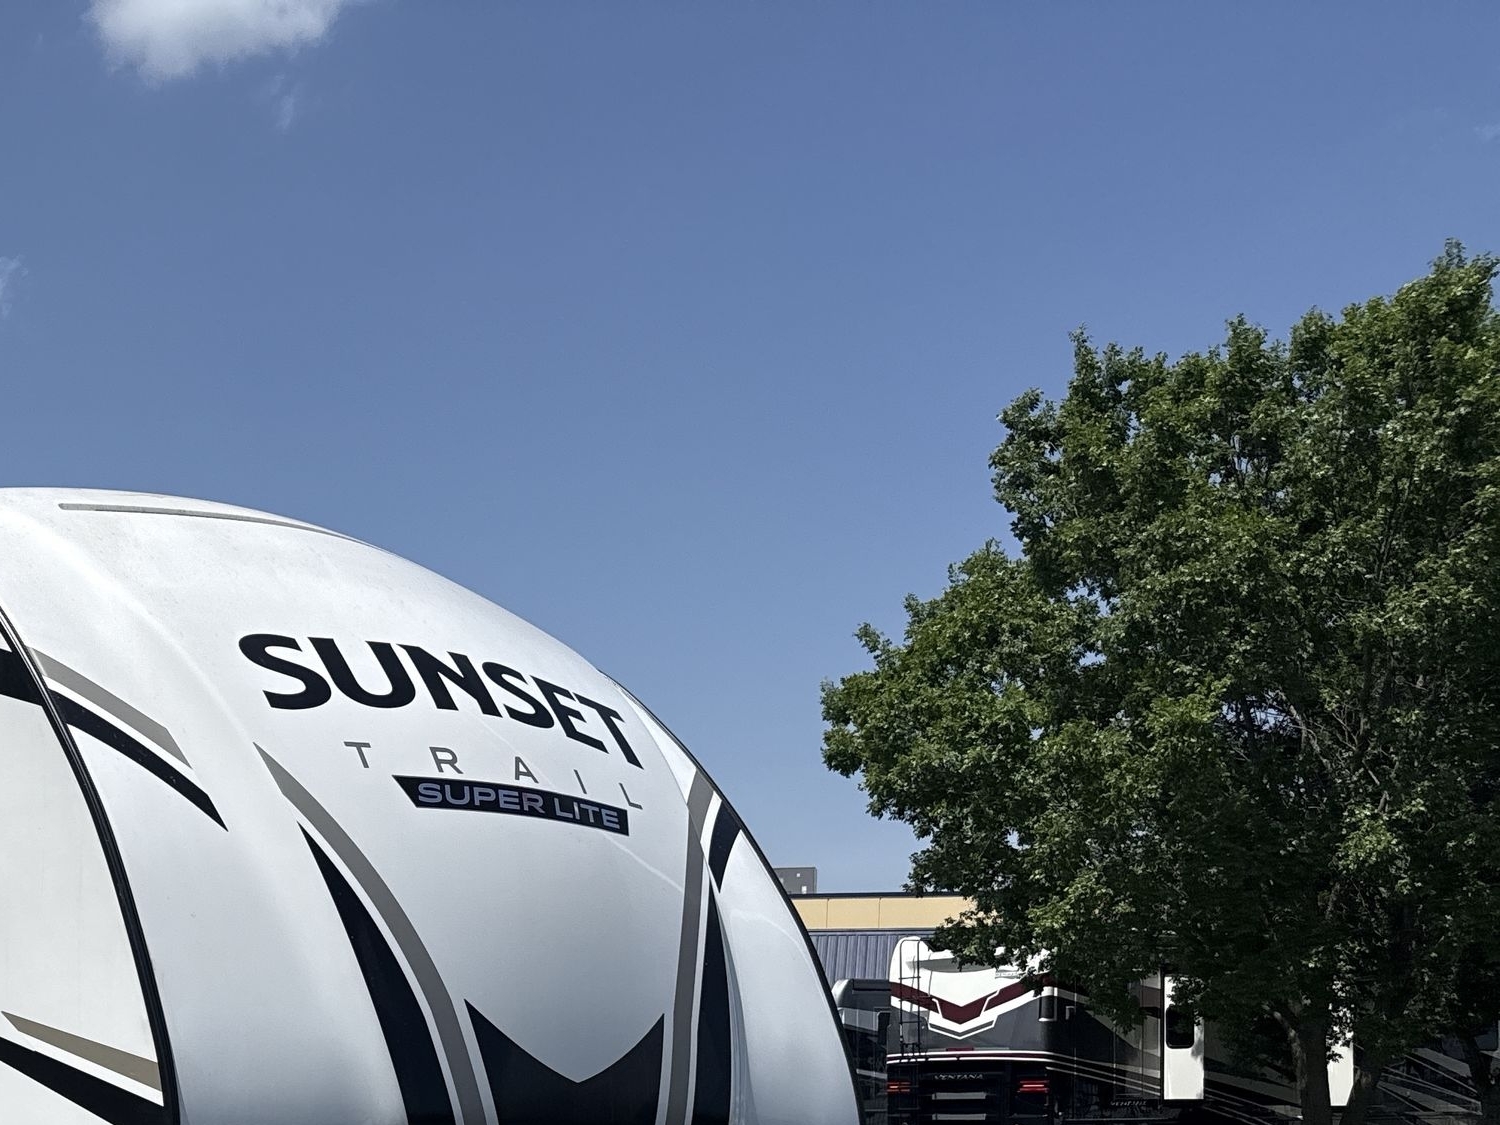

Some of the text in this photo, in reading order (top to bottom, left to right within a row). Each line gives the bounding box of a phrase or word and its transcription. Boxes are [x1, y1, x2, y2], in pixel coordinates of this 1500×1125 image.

[238, 633, 643, 769] SUNSET
[344, 741, 642, 810] TRAIL
[417, 782, 621, 830] SUPER LITE
